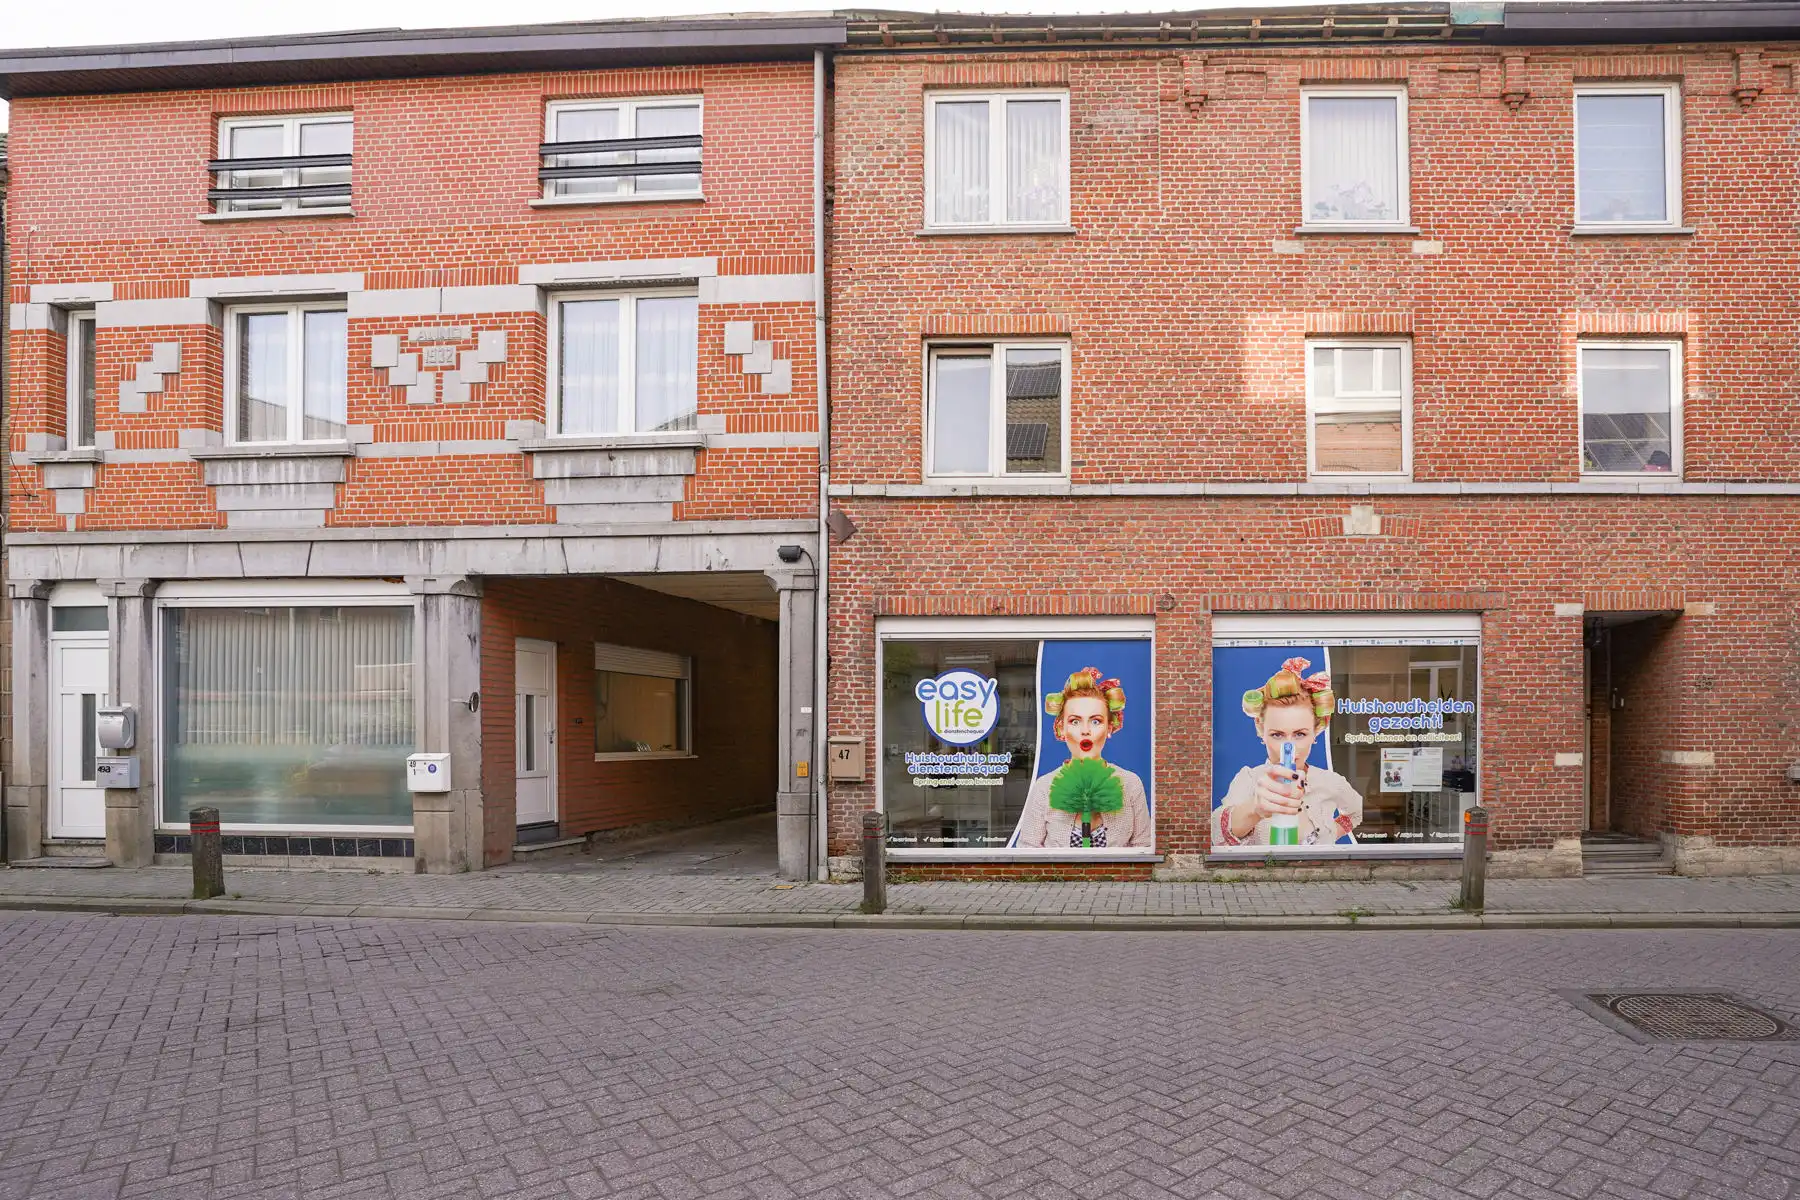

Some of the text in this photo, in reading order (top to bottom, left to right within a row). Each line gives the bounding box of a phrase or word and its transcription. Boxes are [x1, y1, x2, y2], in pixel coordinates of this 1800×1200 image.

[918, 680, 995, 708] easy
[1338, 698, 1474, 713] Huishoudhelden
[936, 700, 983, 733] life
[1369, 714, 1443, 732] gezocht!
[1345, 732, 1374, 744] Spring
[838, 749, 850, 760] 47
[905, 752, 1012, 765] Huishoudhulp met
[908, 764, 1009, 776] dienstencheques
[913, 777, 938, 787] Spring
